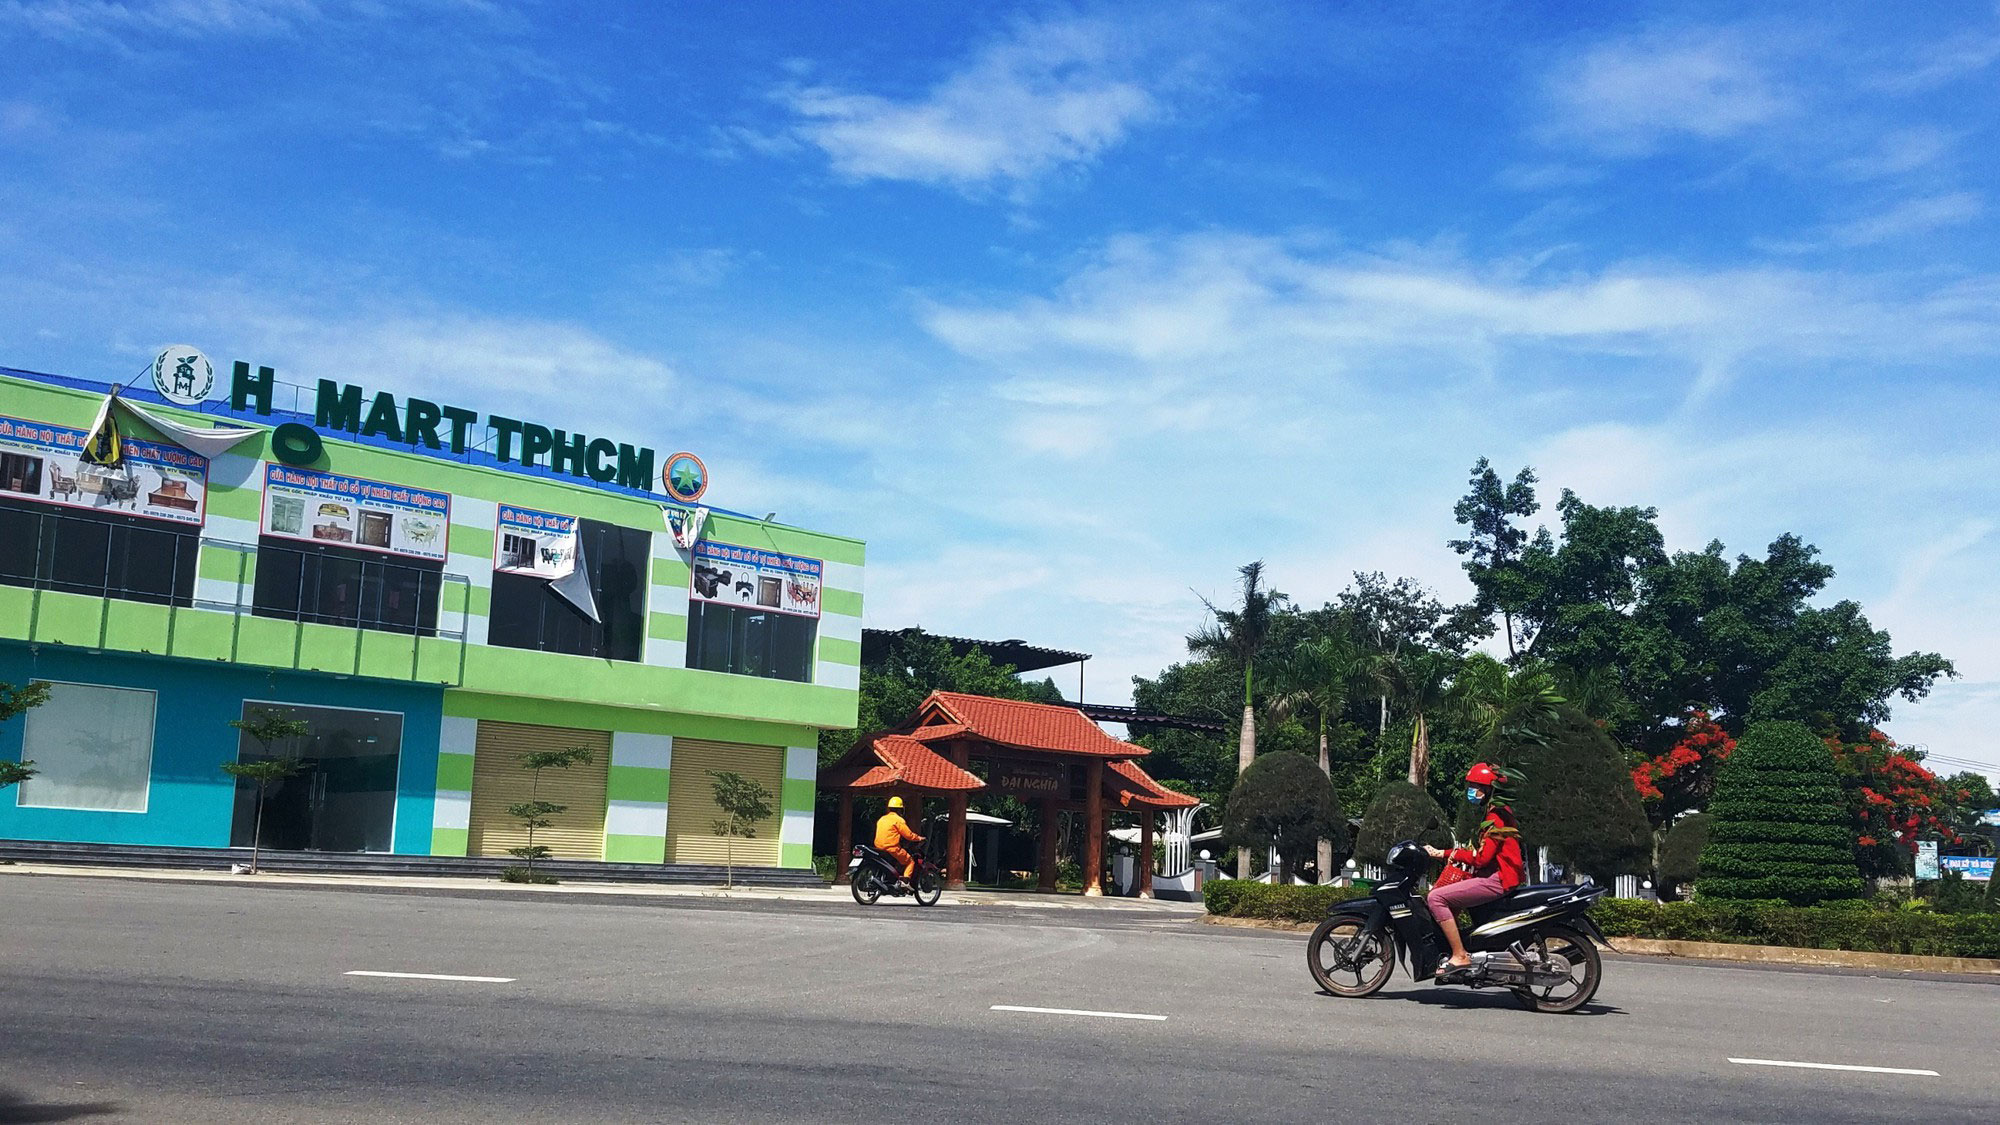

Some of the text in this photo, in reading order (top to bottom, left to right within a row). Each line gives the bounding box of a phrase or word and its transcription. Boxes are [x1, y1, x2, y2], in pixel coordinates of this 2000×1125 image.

[15, 424, 38, 440] HÀNG
[39, 429, 54, 446] NỘI
[56, 431, 77, 446] THẤT
[314, 378, 477, 454] MART
[488, 414, 655, 491] TPHCM
[141, 446, 160, 460] CHẤT
[162, 449, 187, 466] LƯỢNG
[188, 455, 204, 467] CAO
[270, 467, 446, 509] CỬA HÀNG NỘI THẤT ĐỒ GỖ TỰ NHIÊN CHẤT LƯỢNG CAO
[502, 508, 514, 522] CỬA
[515, 511, 533, 525] HÀNG
[533, 514, 545, 529] NỘI
[545, 516, 560, 530] THẤT
